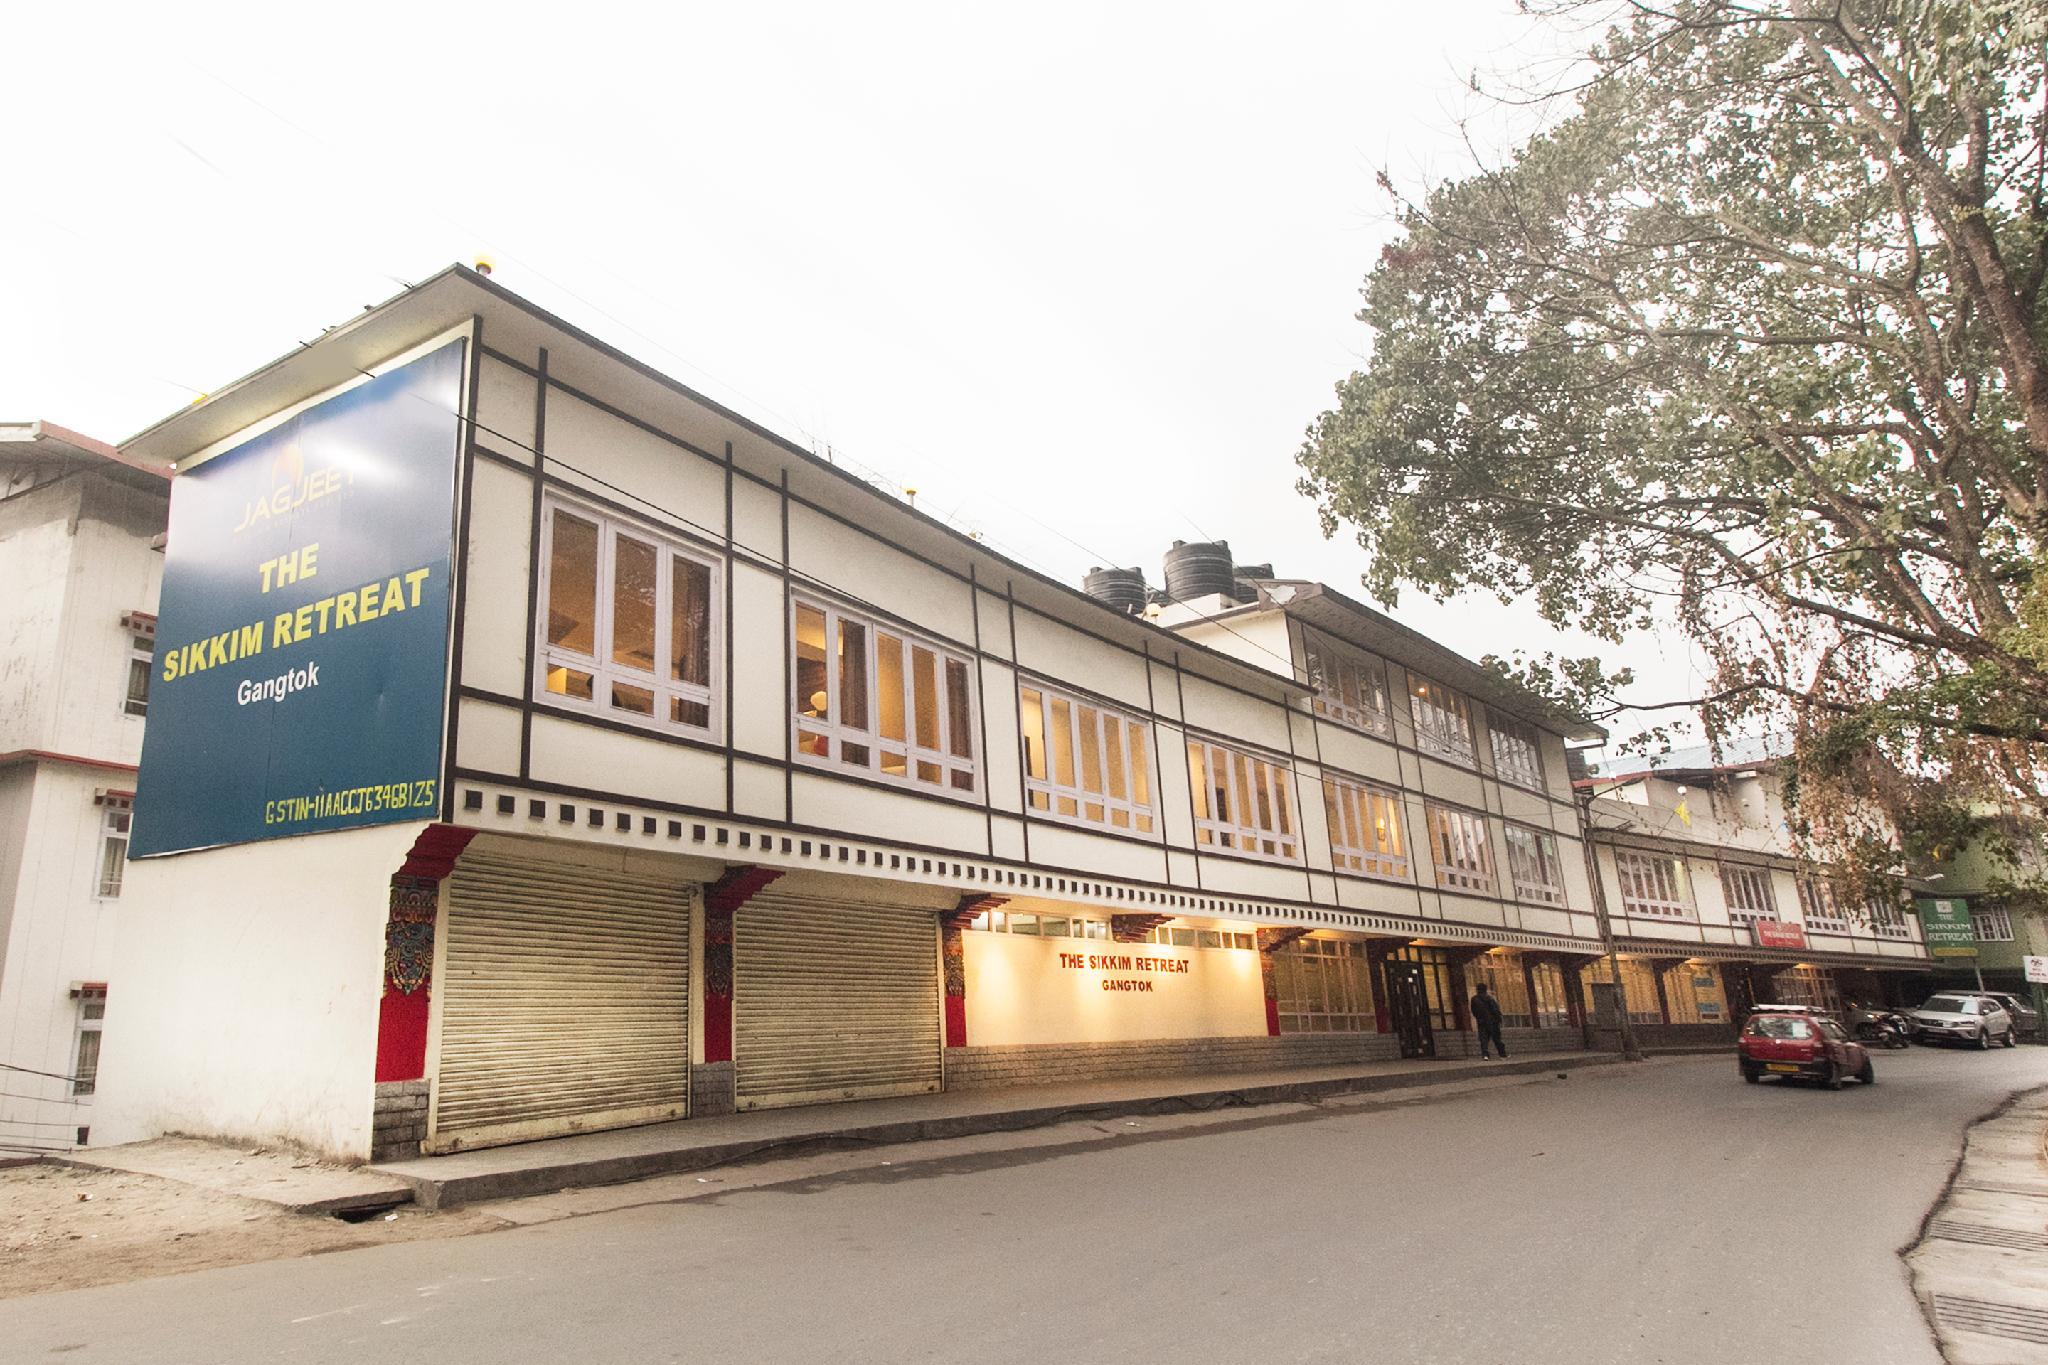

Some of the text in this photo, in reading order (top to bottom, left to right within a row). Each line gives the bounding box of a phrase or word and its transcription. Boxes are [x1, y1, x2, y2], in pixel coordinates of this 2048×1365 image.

[259, 542, 320, 593] THE
[162, 567, 430, 682] SIKKIM RETREAT
[237, 660, 320, 706] Gangtok
[1928, 932, 1974, 941] RETREAT
[1059, 953, 1189, 973] THE SIKKIM RETREAT
[1102, 979, 1153, 992] GANGTOK
